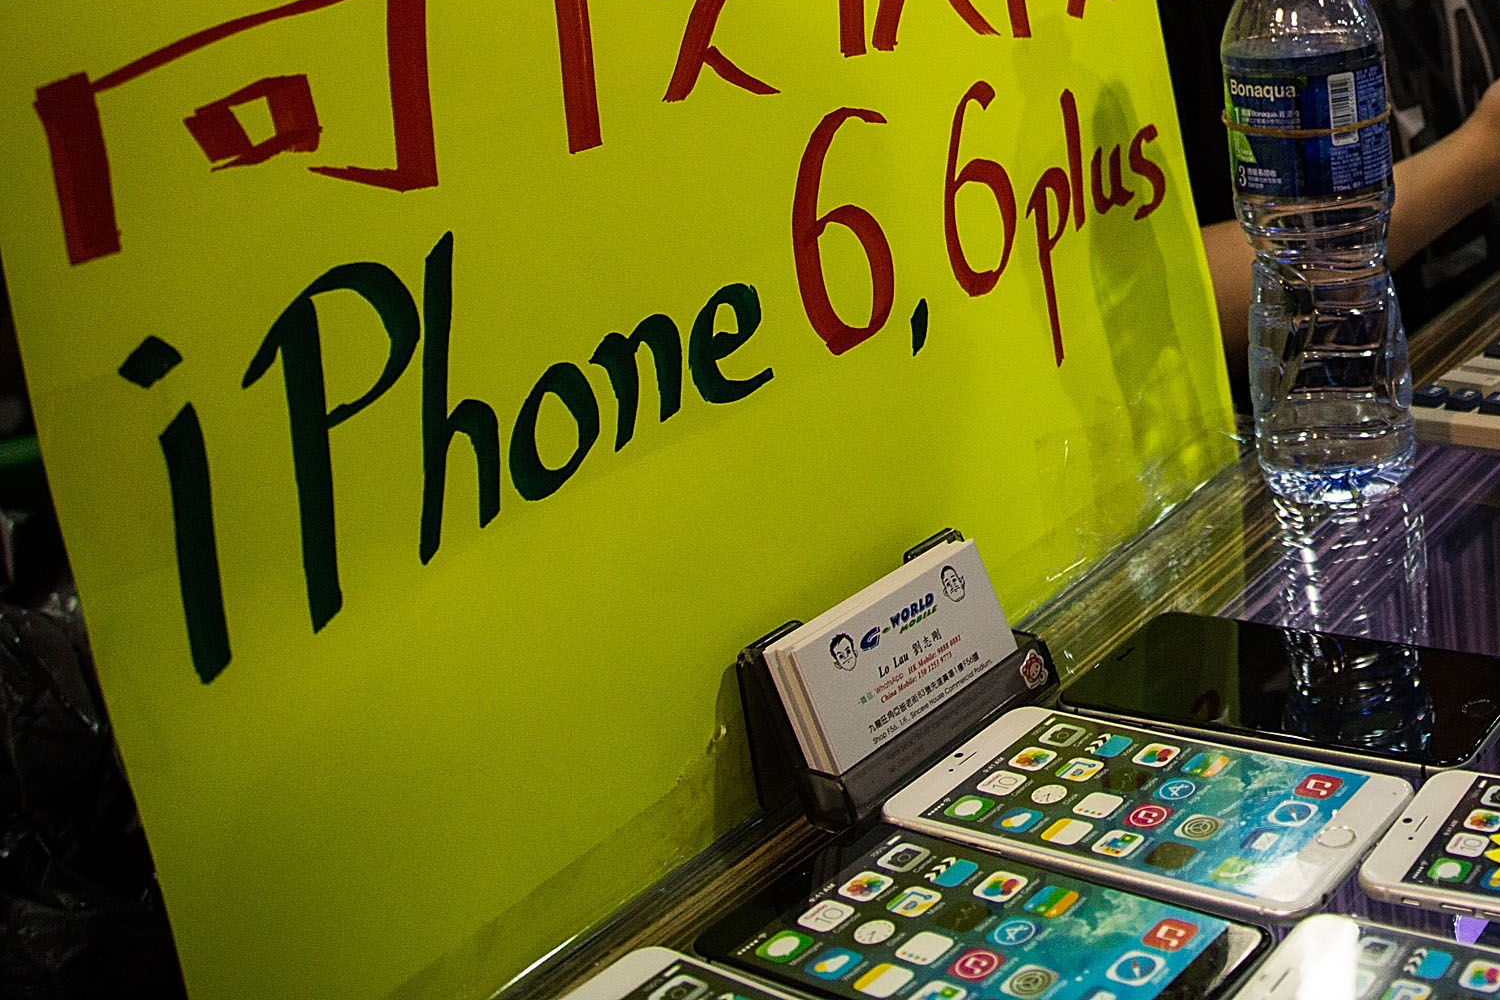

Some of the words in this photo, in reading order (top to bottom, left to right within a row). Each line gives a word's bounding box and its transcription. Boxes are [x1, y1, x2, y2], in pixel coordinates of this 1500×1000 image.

[1229, 79, 1297, 101] Bonaqua
[119, 231, 774, 685] iPhone
[899, 604, 937, 633] MOBILE
[874, 672, 903, 693] WhatsApp
[907, 663, 917, 674] HK
[917, 652, 936, 668] Mobile:
[877, 665, 889, 678] Lo
[892, 653, 909, 668] Lau
[880, 689, 897, 703] China
[897, 676, 917, 692] Mobile:
[872, 731, 887, 744] Shop
[909, 702, 929, 718] Sincere
[928, 692, 944, 705] House
[944, 670, 974, 694] Commercial
[988, 775, 1021, 791] 10
[1457, 837, 1485, 852] 10
[809, 906, 848, 925] 10
